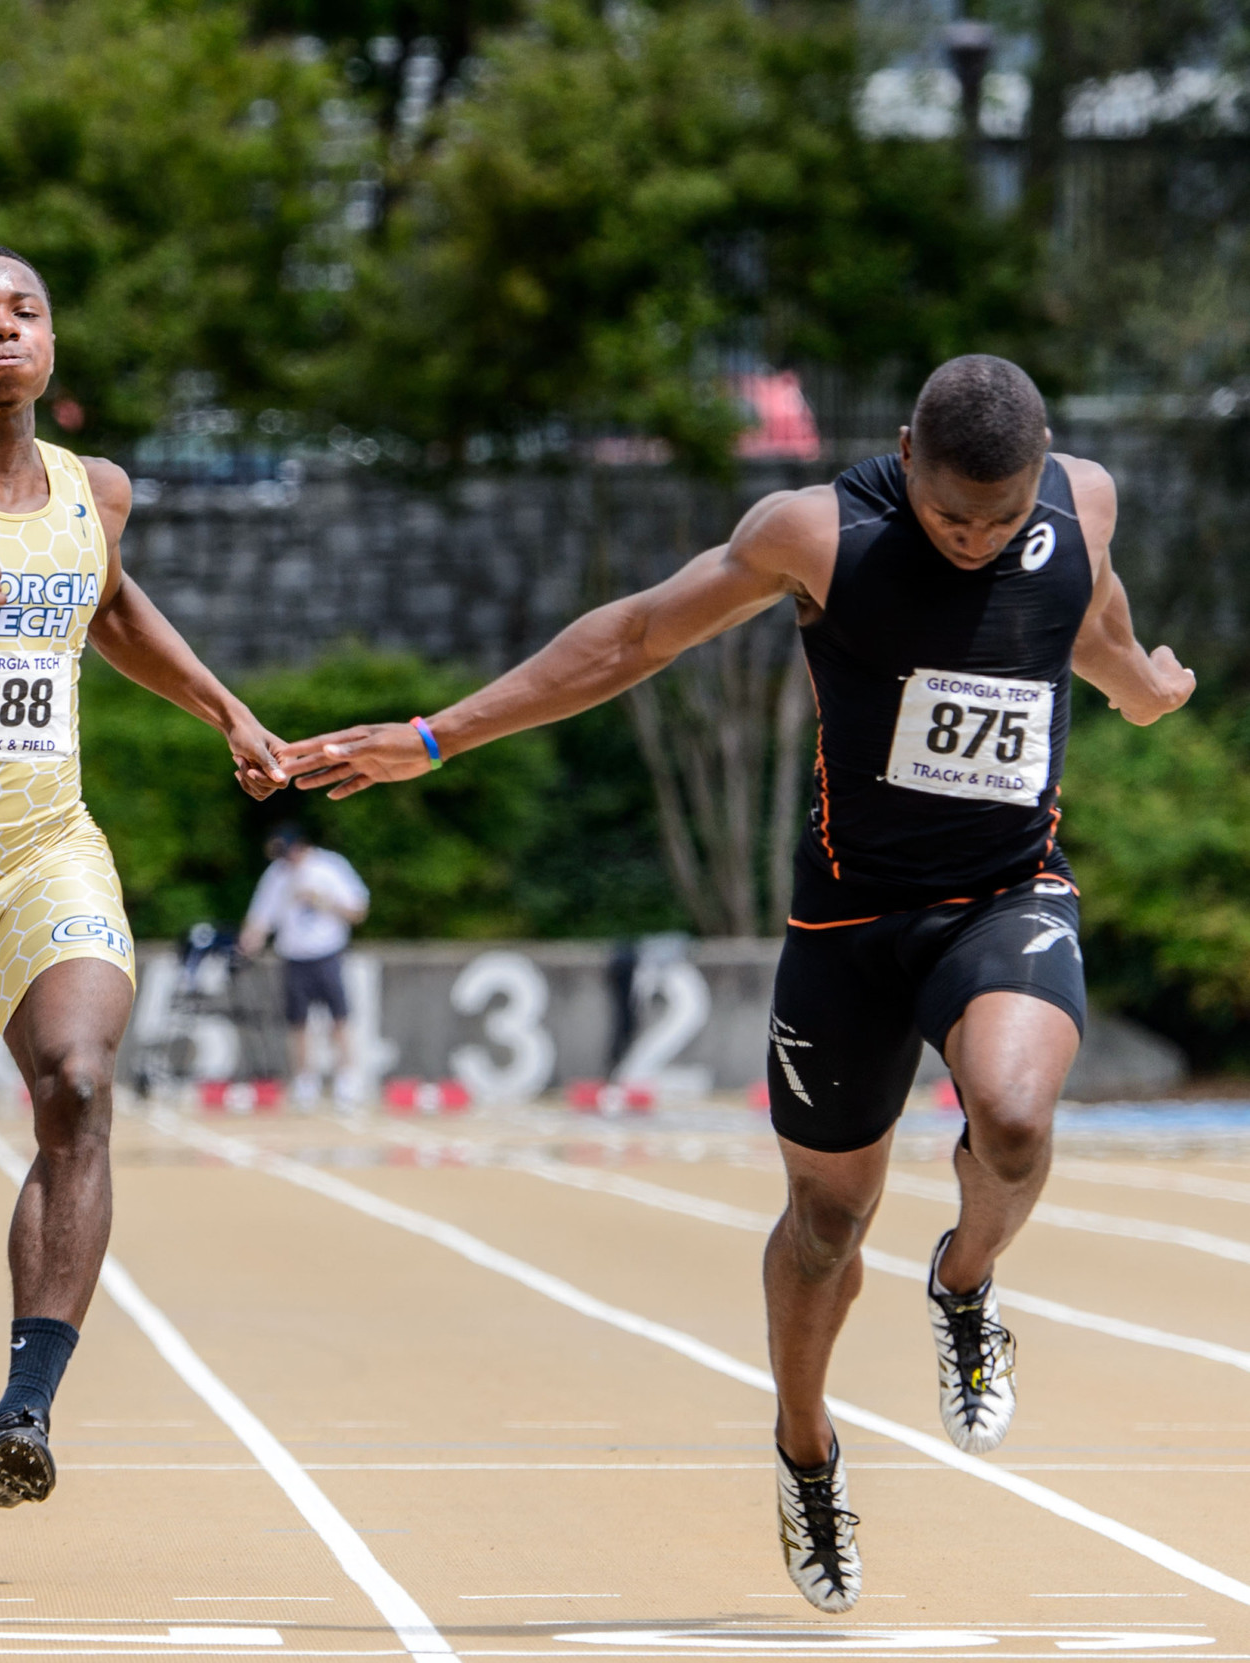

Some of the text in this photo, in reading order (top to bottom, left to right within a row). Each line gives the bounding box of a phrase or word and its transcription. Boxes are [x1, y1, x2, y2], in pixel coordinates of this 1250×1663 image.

[34, 657, 60, 670] TECH
[927, 677, 1040, 702] GEORGIA TECH
[7, 739, 17, 751] &
[22, 740, 56, 751] FIELD
[926, 702, 1029, 764] 875
[913, 762, 1025, 790] TRACK & FIELD
[52, 915, 132, 957] GT
[451, 950, 556, 1100] 3
[610, 945, 713, 1096] 2
